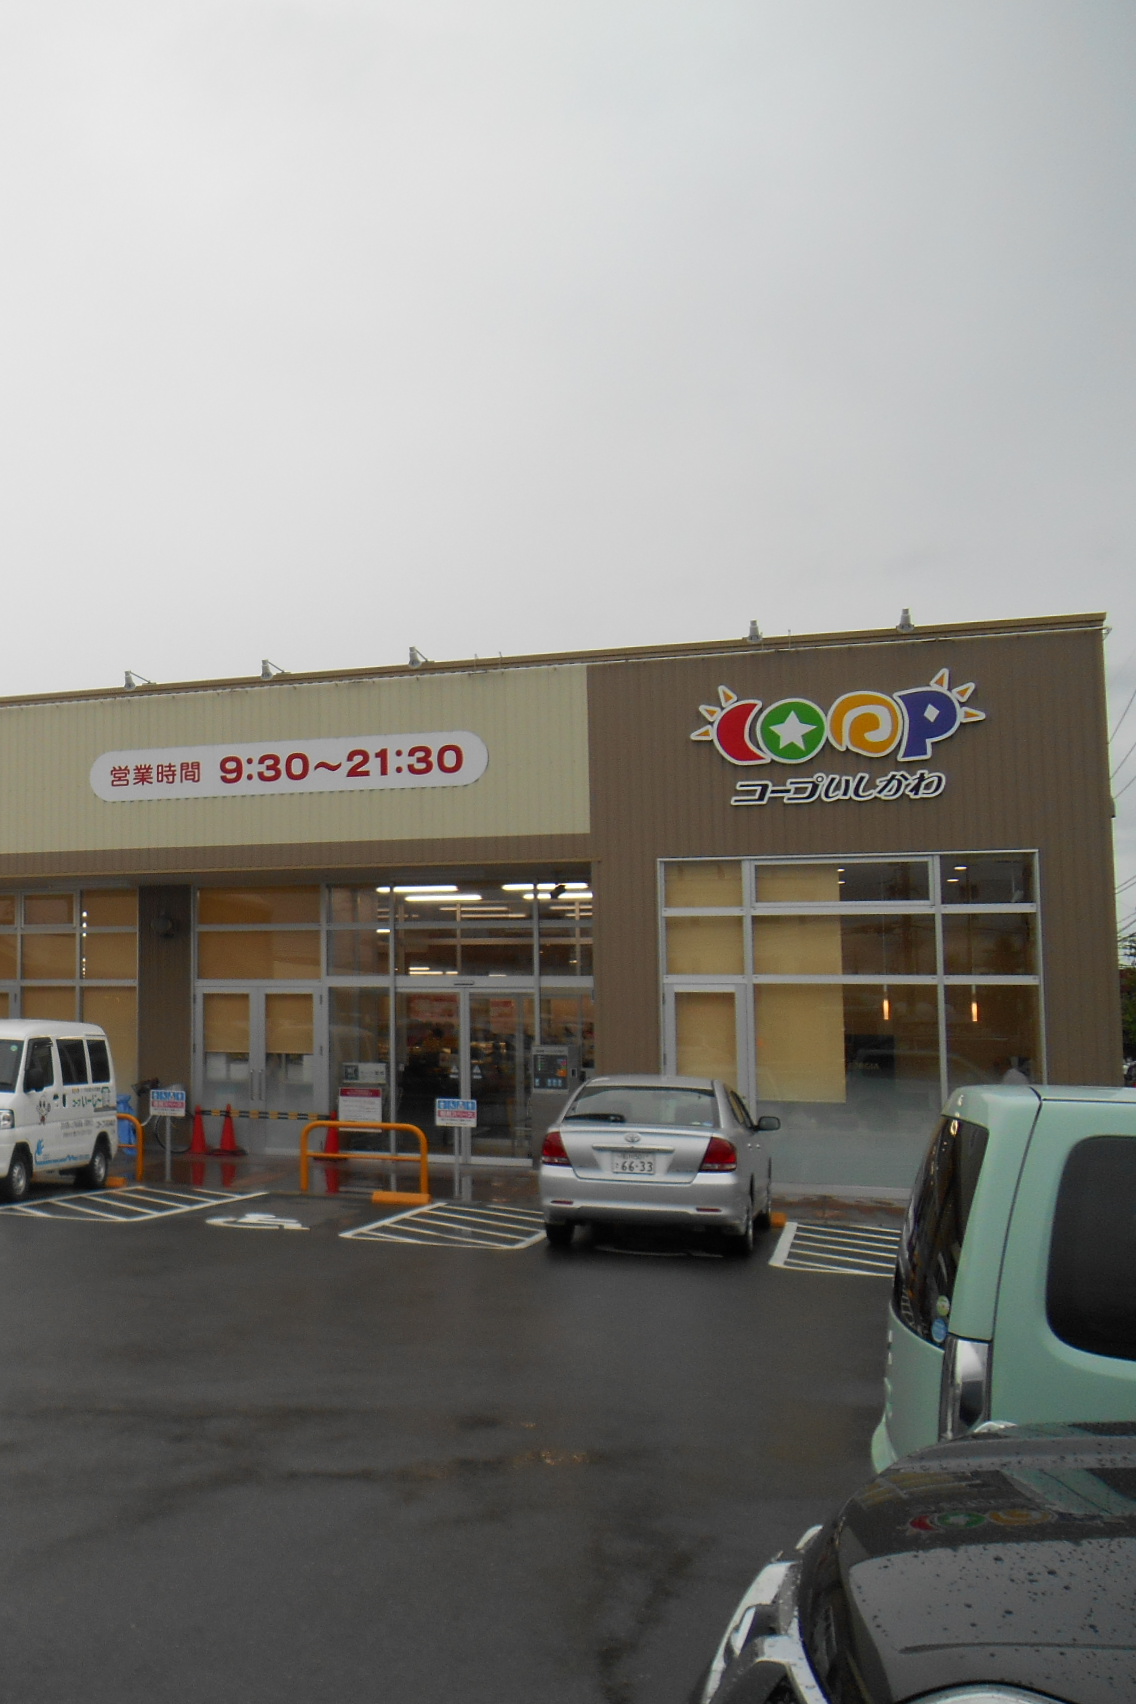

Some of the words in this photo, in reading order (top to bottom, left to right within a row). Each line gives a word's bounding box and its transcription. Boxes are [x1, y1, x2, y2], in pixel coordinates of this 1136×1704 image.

[713, 685, 963, 766] COOP
[109, 760, 202, 788] 営業時間
[218, 743, 465, 785] 9:30～21:30
[731, 769, 946, 806] コープいしかわ
[621, 1160, 654, 1172] 66-33
